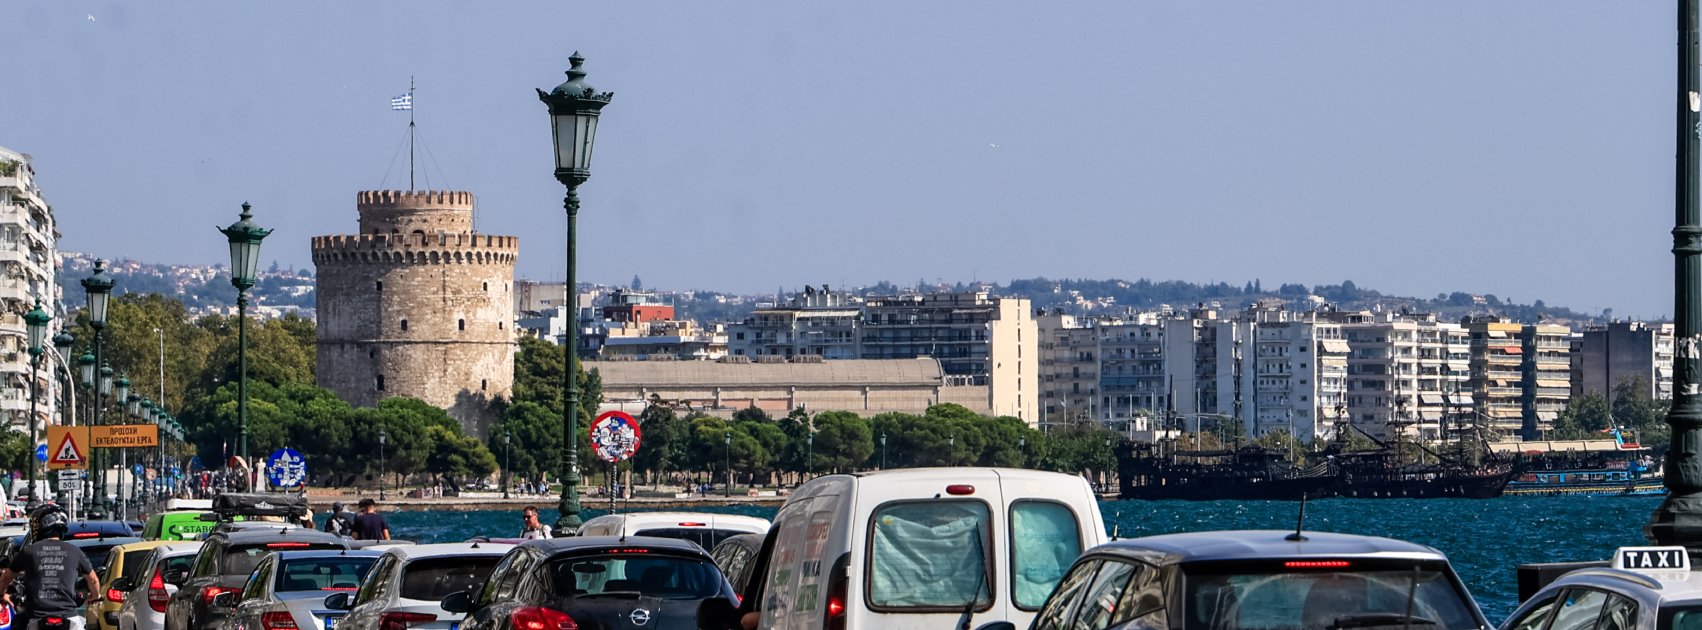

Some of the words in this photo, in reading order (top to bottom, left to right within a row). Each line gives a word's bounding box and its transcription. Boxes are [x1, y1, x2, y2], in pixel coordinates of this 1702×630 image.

[96, 436, 136, 445] ΕΚΤΕΛΟΥΝΤΑΙ
[136, 436, 152, 444] ΕΡΓΑ
[1626, 551, 1680, 567] TAXI
